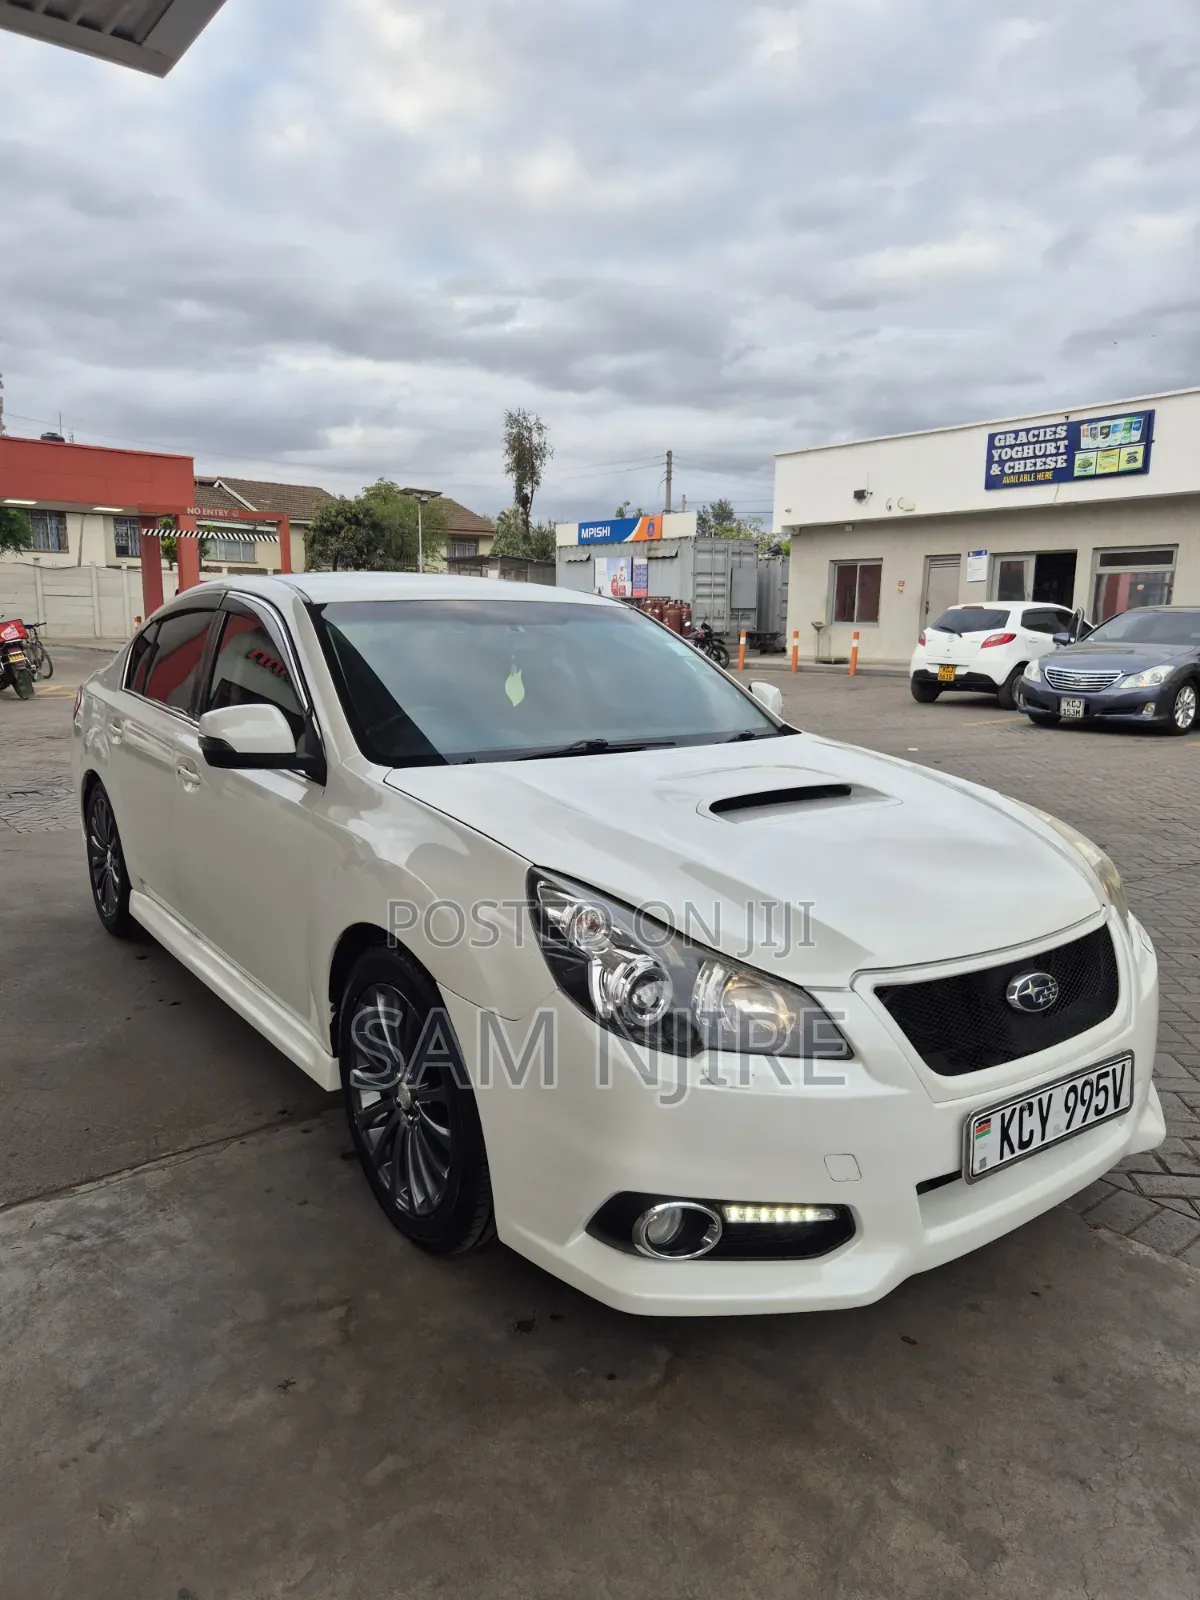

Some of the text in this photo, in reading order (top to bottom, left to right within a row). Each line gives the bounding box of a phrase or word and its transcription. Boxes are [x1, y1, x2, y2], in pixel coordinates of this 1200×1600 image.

[994, 426, 1067, 446] GRACIES
[992, 440, 1068, 461] YOGHURT
[990, 455, 1067, 475] & CHEESE
[1002, 471, 1053, 484] AVAILABLE HERE
[187, 506, 200, 515] NO
[581, 526, 610, 538] MPISHI
[1066, 700, 1081, 708] KCJ
[1063, 708, 1080, 717] 153M
[1000, 1063, 1126, 1161] KCY 995V
